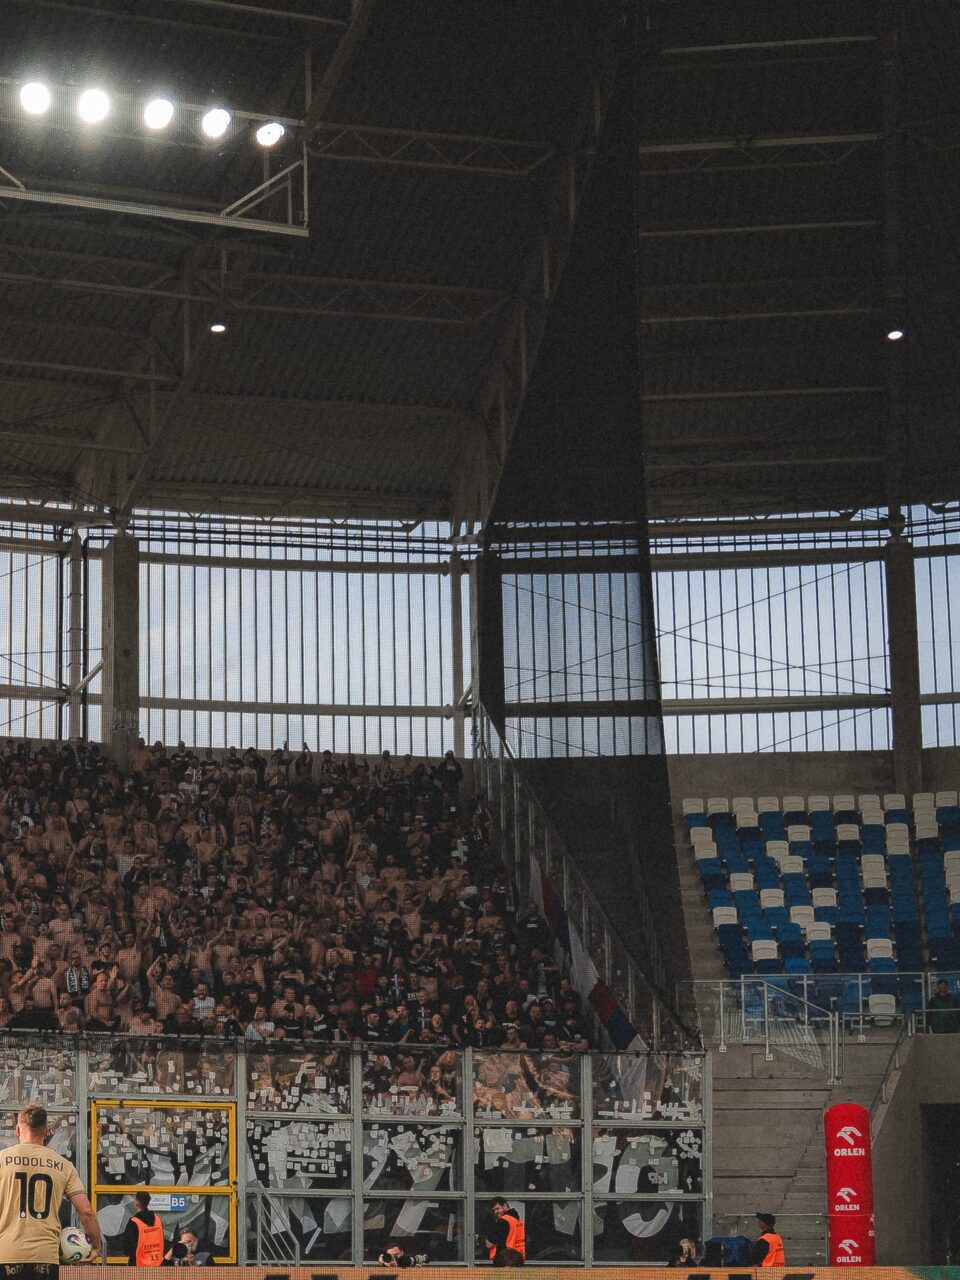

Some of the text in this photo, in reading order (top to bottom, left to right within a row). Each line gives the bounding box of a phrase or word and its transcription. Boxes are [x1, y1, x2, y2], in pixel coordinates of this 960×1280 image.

[834, 1148, 866, 1157] ORLEN
[5, 1156, 64, 1172] PODOLSKI
[14, 1172, 53, 1219] 10
[171, 1197, 185, 1207] B5
